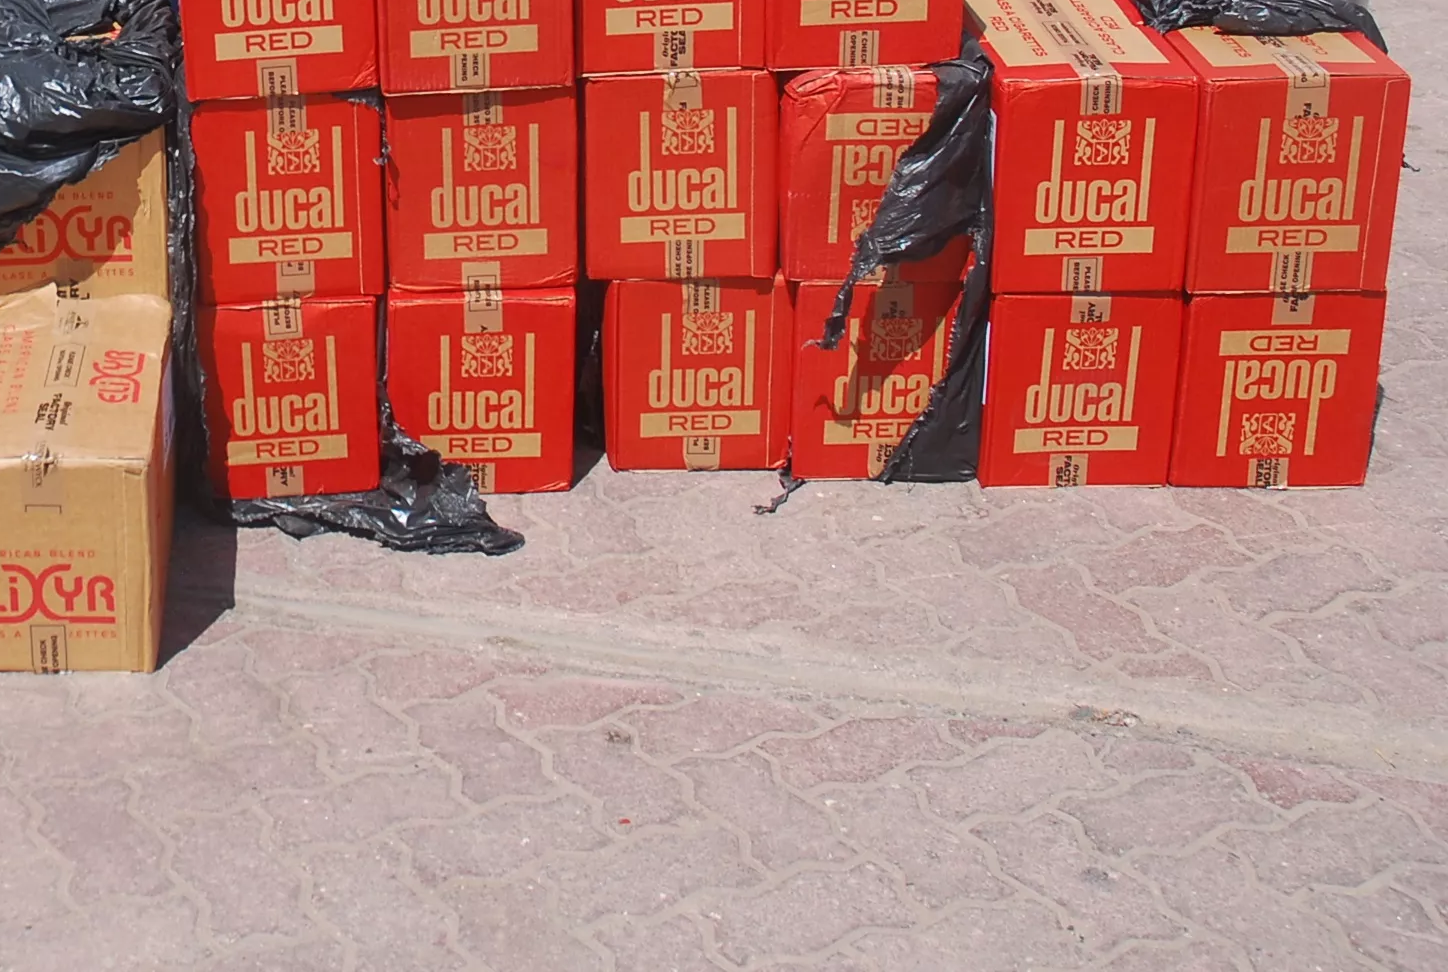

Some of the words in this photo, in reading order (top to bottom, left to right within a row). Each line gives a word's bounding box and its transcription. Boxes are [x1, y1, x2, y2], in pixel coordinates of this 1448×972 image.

[636, 8, 704, 29] RED
[245, 31, 314, 54] RED
[440, 29, 509, 51] RED
[628, 107, 737, 212] ducal
[1238, 116, 1364, 223] ducal
[235, 126, 344, 233] ducal
[431, 123, 540, 229] ducal
[1035, 118, 1156, 225] ducal
[650, 216, 717, 237] RED
[258, 237, 325, 258] RED
[453, 232, 520, 253] RED
[1054, 230, 1124, 249] RED
[1257, 229, 1328, 247] RED
[1248, 334, 1319, 352] RED
[648, 310, 754, 409] ducal
[428, 332, 535, 430] ducal
[1024, 326, 1141, 424] ducal
[232, 335, 339, 437] ducal
[1216, 359, 1338, 456] ducal
[668, 414, 733, 431] RED
[448, 436, 513, 453] RED
[1042, 429, 1110, 447] RED
[255, 439, 320, 459] RED
[49, 549, 96, 559] BLEND
